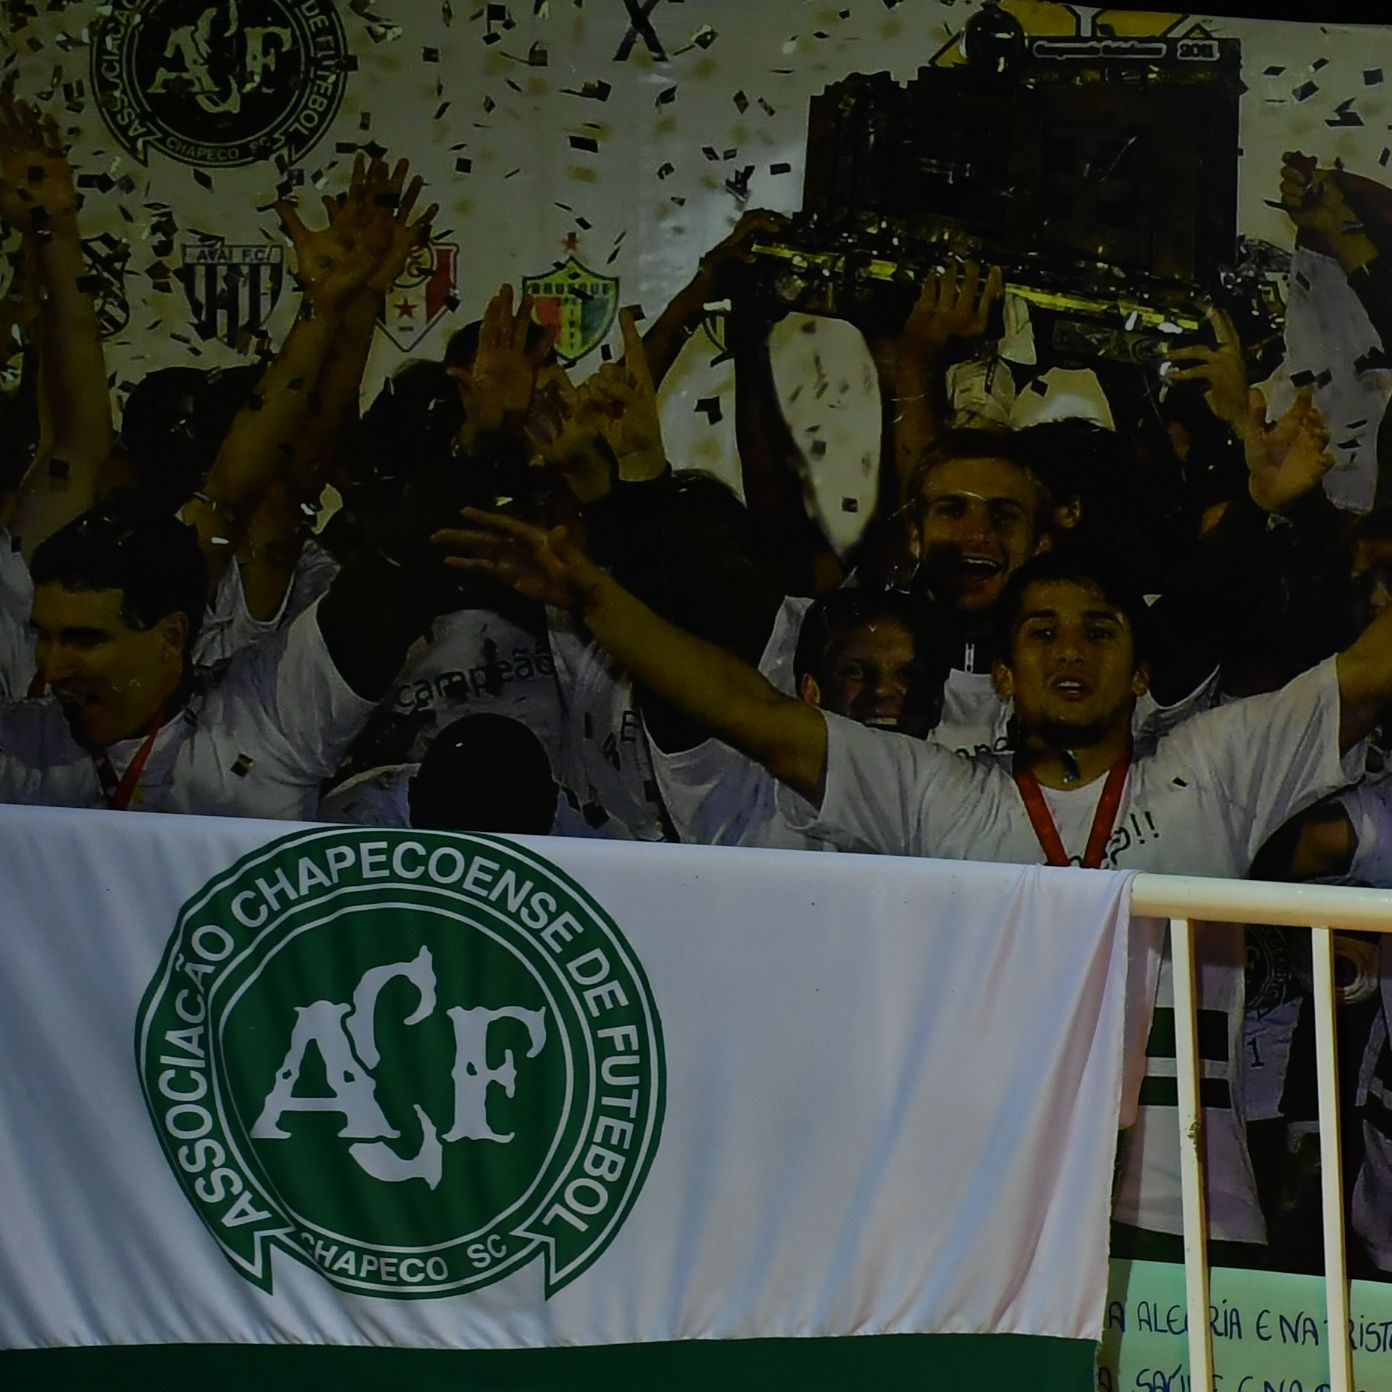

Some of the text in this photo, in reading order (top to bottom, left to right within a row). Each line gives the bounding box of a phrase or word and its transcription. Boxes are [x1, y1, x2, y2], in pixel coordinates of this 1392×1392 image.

[157, 840, 642, 1235] ASSOCIAÇÃO CHAPECOENSE DE FUTEBOL
[466, 1232, 508, 1270] SC
[1137, 1298, 1243, 1339] ALERIA
